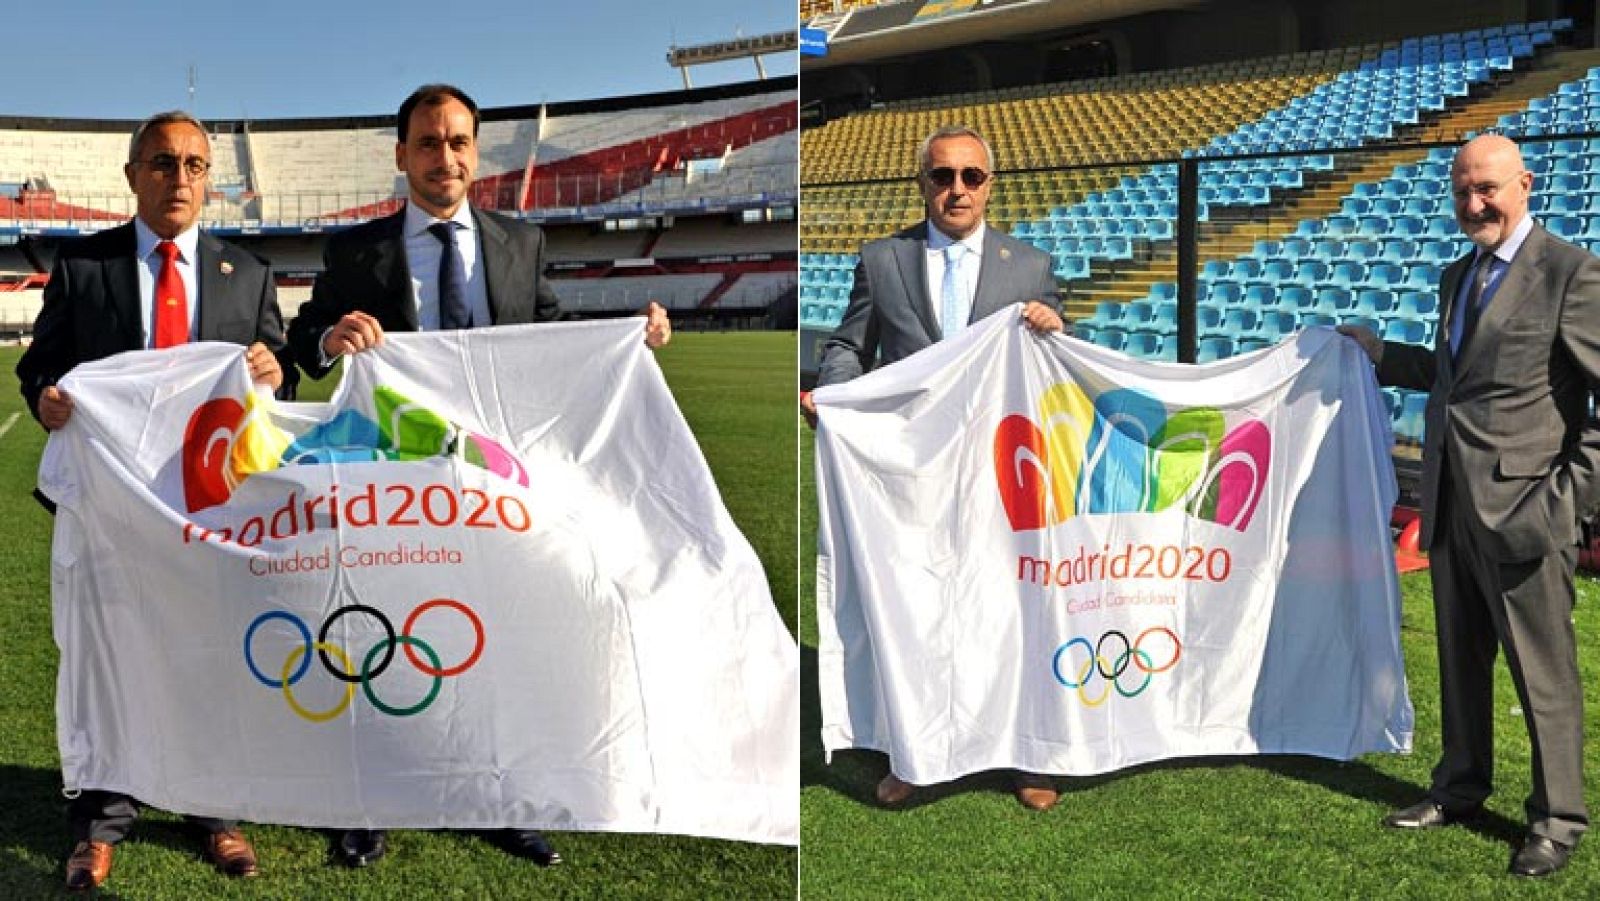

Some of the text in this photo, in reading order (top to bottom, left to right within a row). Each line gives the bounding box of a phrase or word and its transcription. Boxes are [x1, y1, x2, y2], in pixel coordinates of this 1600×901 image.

[249, 541, 463, 576] Ciudad Candidata
[1017, 544, 1232, 587] madrid2020
